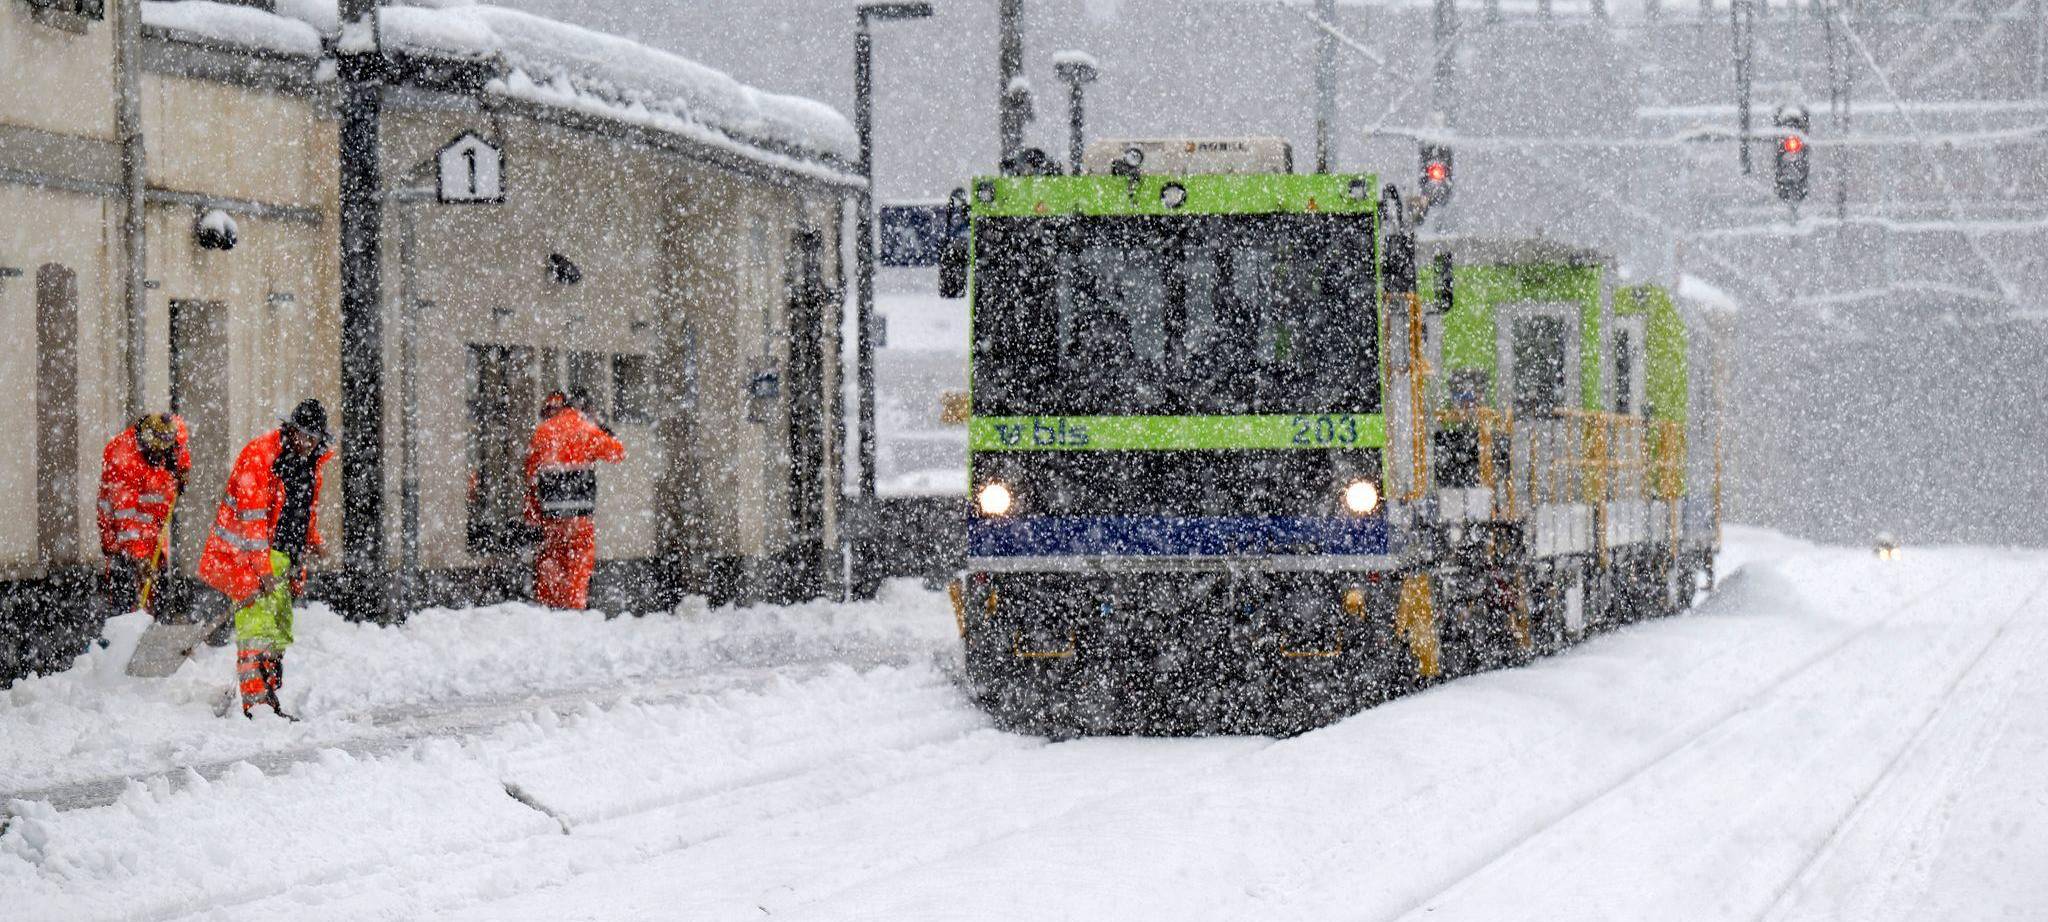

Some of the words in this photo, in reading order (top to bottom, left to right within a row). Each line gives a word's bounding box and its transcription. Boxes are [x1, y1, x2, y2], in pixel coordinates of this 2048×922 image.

[462, 147, 475, 194] 1
[1033, 417, 1089, 446] bls
[1292, 413, 1357, 445] 203
